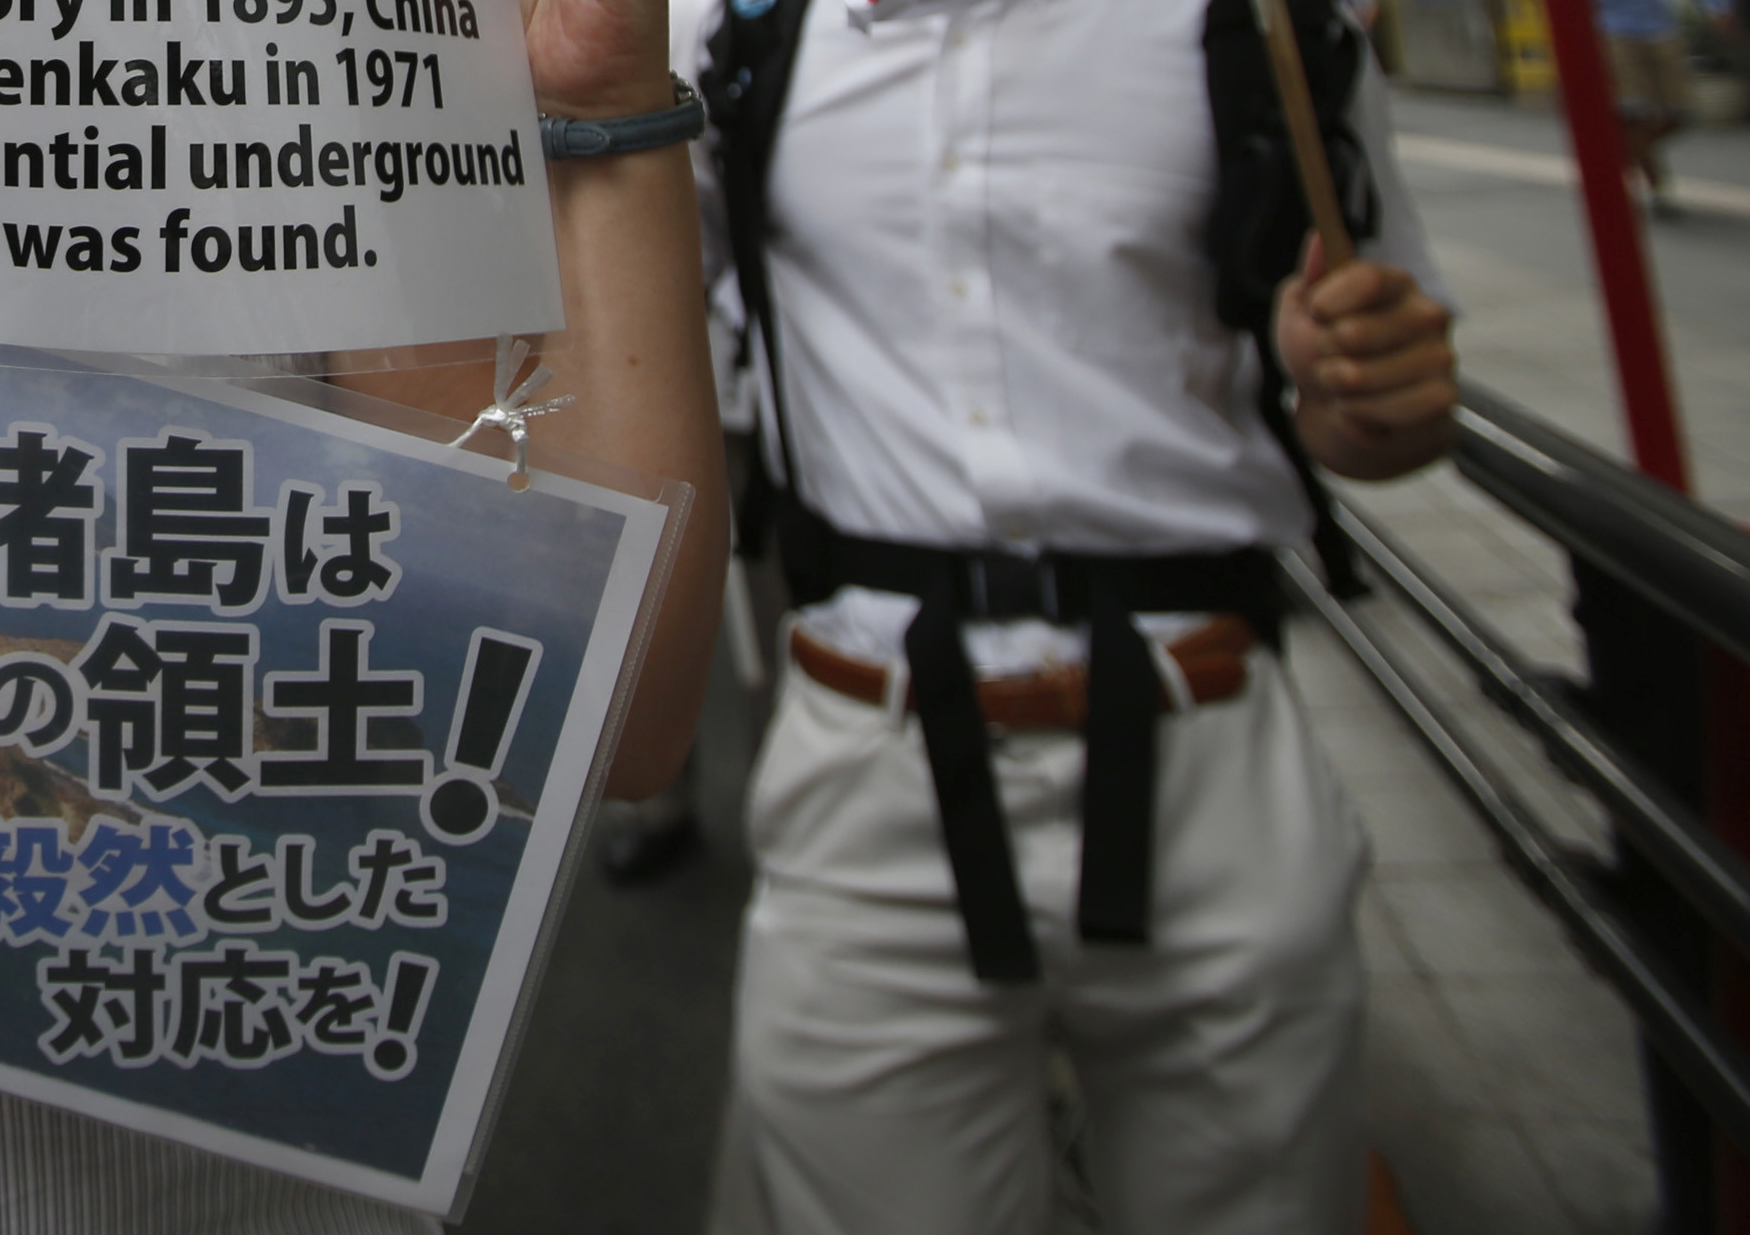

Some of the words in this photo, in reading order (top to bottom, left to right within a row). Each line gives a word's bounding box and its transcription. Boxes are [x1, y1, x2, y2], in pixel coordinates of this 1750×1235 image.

[265, 43, 321, 107] in
[334, 47, 446, 110] 1971
[189, 128, 526, 203] underground
[3, 221, 143, 273] was
[160, 207, 378, 274] found.
[46, 950, 440, 1077] 対応を!
